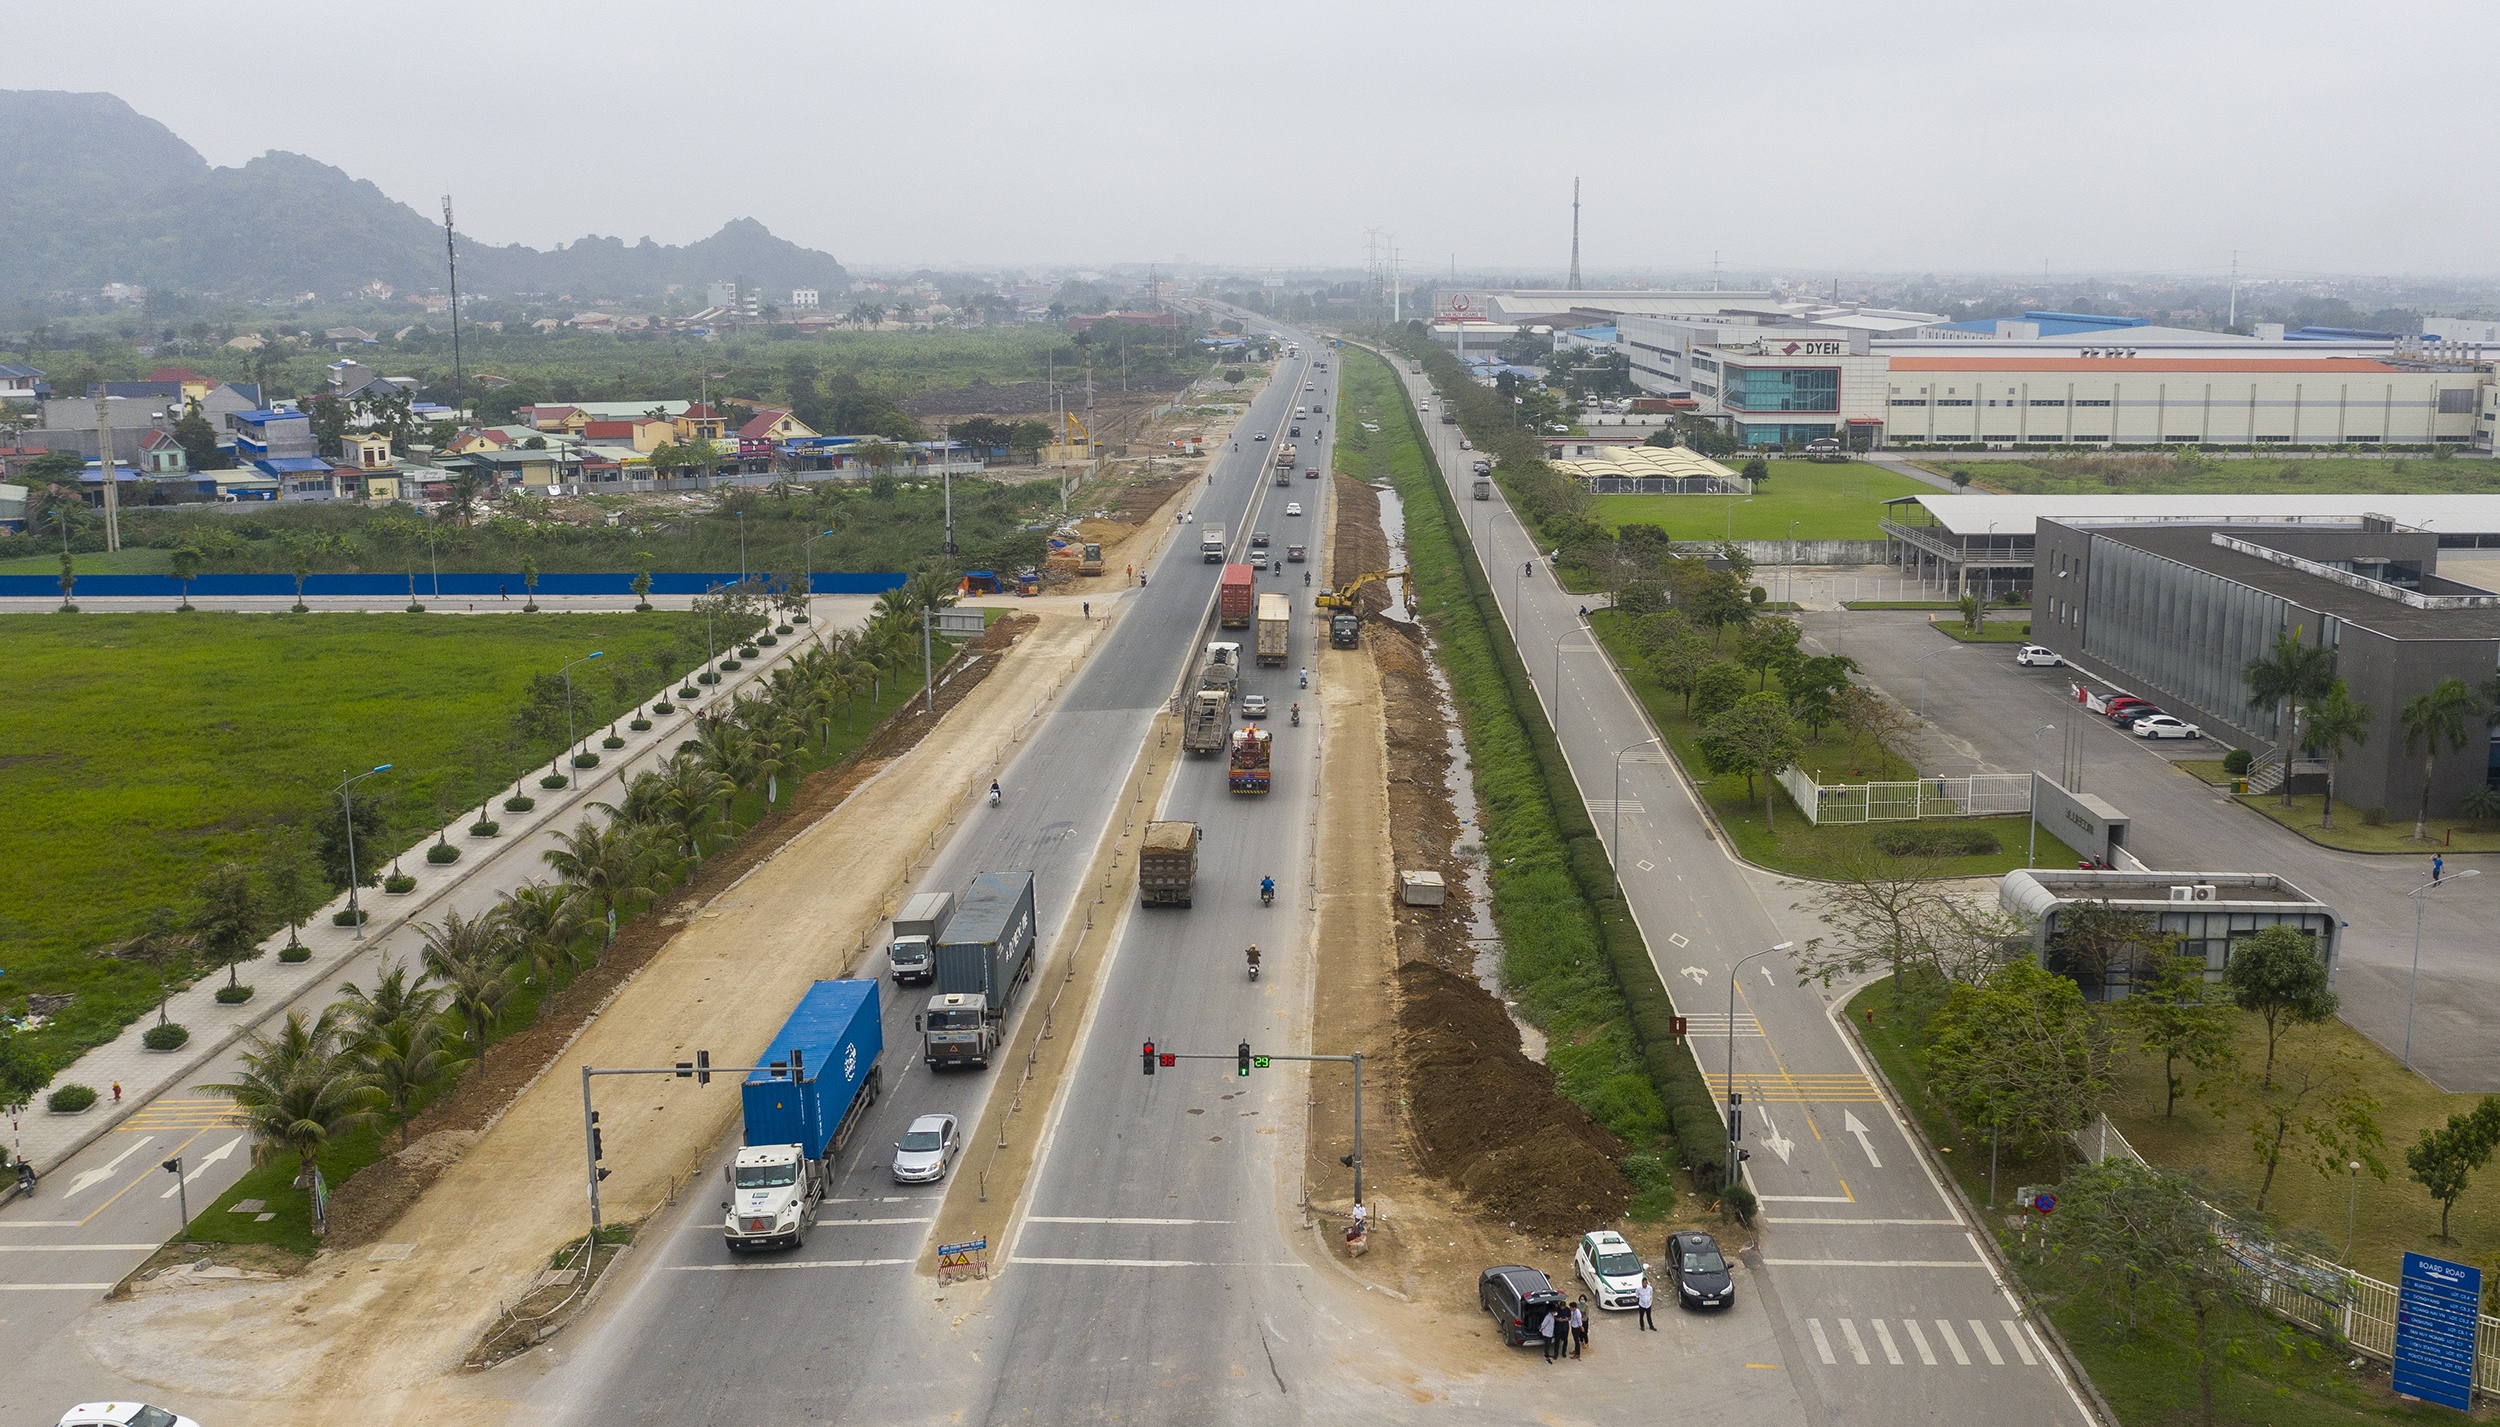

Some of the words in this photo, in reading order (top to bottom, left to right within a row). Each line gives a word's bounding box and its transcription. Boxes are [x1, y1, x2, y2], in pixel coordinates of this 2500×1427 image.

[1806, 343, 1840, 355] DYEH
[1255, 1056, 1269, 1067] 29
[2419, 1261, 2443, 1272] BOARD
[2445, 1268, 2466, 1278] ROAD
